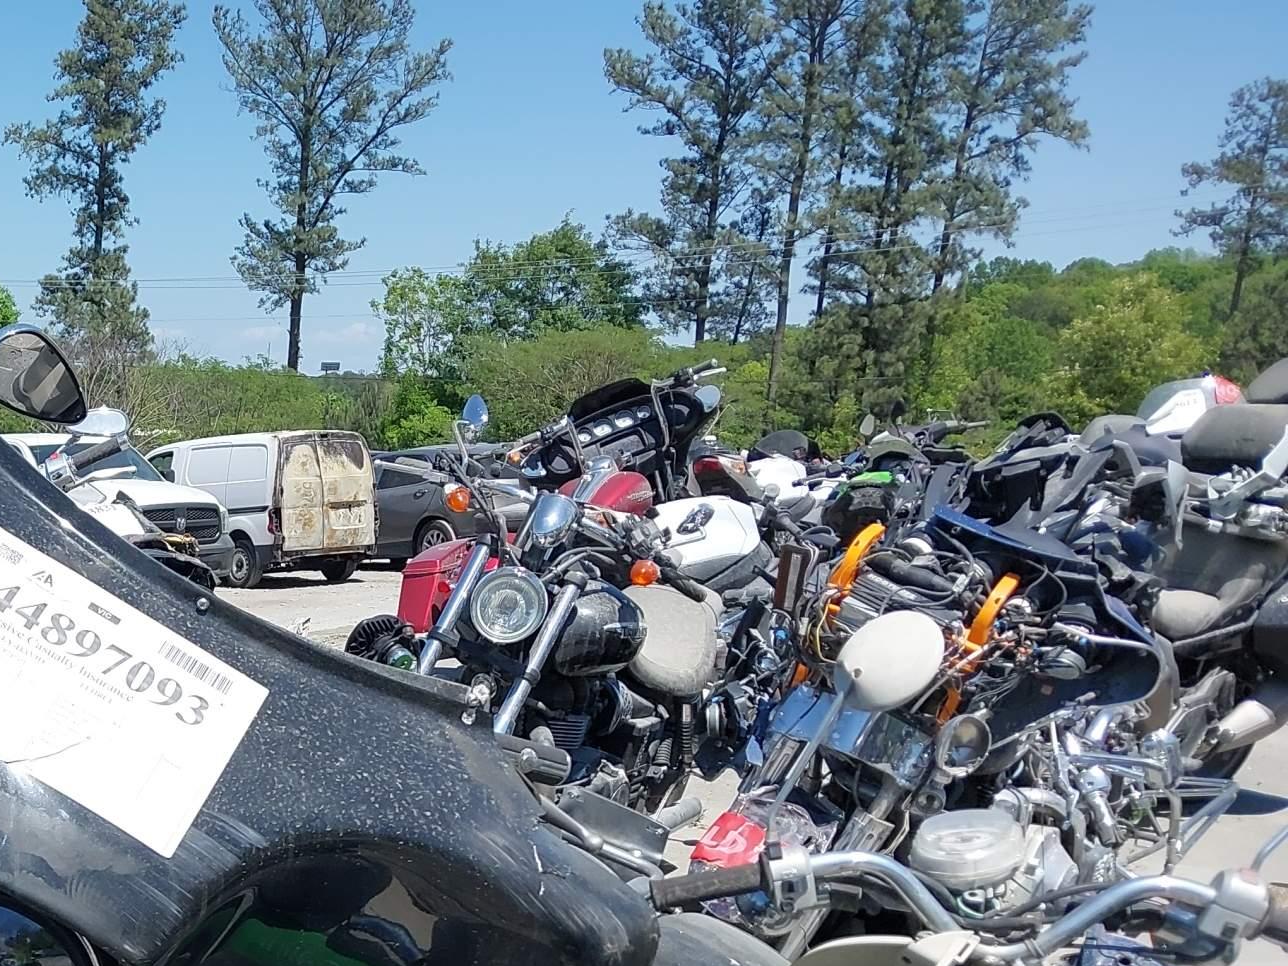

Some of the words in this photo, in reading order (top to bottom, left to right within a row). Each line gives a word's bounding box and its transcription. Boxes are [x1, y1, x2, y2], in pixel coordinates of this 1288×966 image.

[96, 605, 113, 621] VIC
[26, 634, 74, 671] Casualty
[78, 664, 135, 704] Insurance
